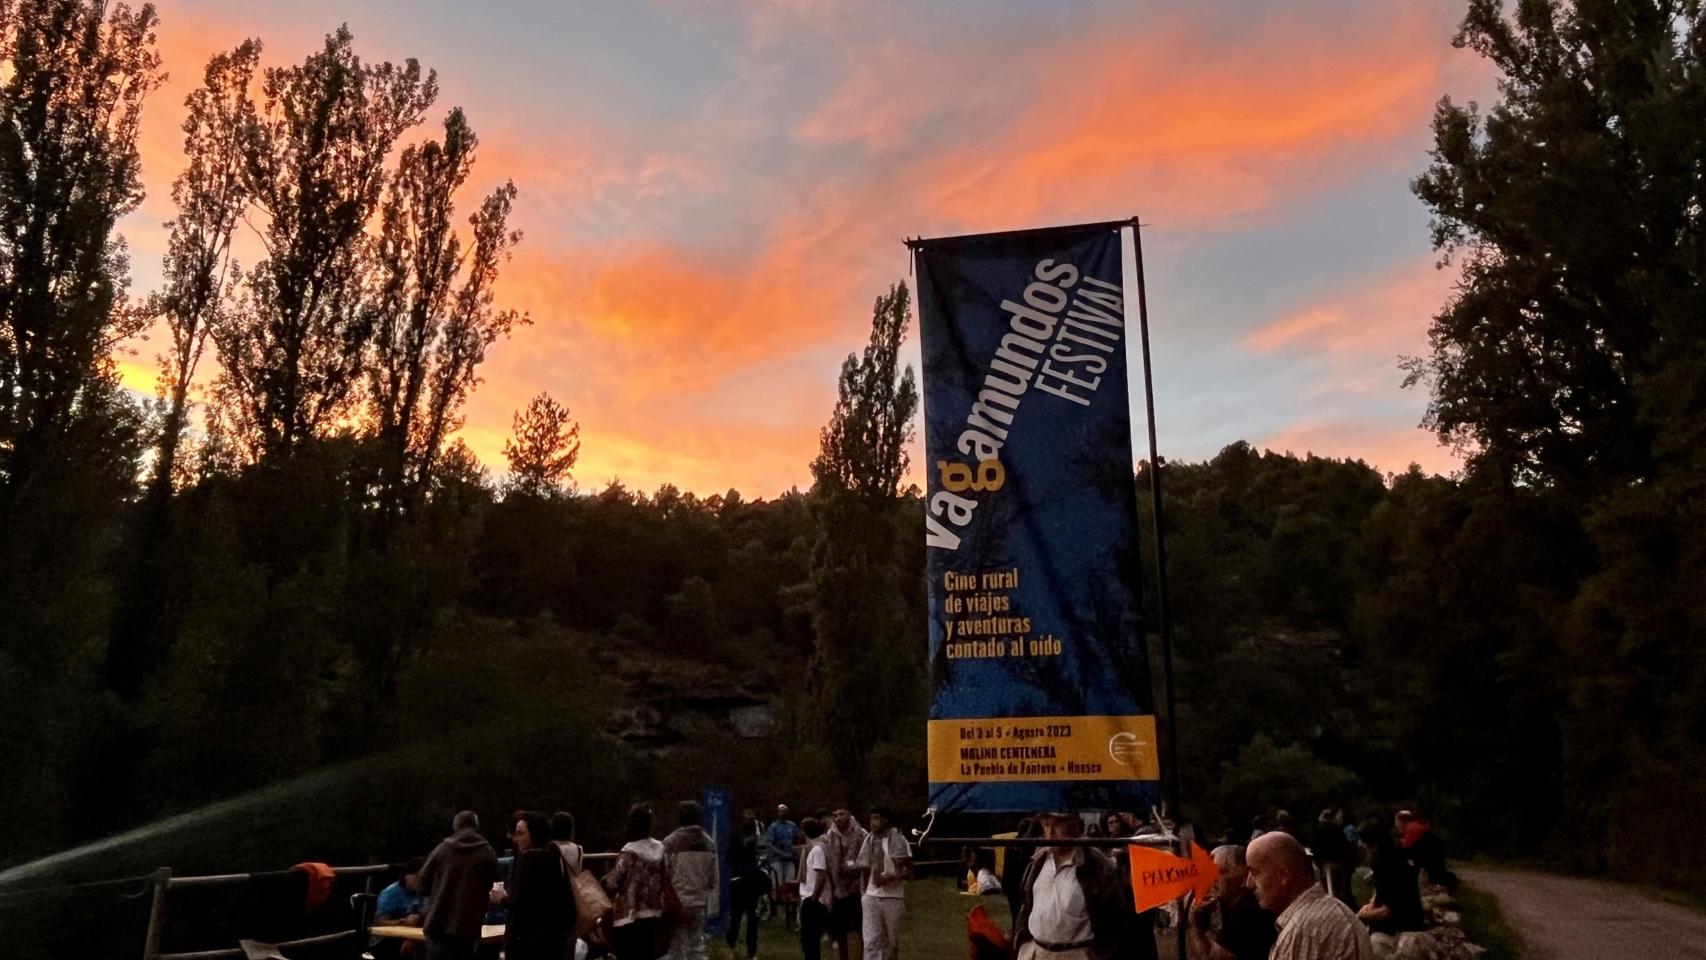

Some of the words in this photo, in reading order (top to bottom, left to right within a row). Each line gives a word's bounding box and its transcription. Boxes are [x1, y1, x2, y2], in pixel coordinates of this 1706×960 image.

[926, 258, 1079, 550] vagamundos
[944, 570, 976, 591] Cine
[982, 568, 1018, 589] rural
[945, 593, 962, 614] de
[966, 592, 1010, 616] viajes
[945, 620, 953, 641] y
[957, 616, 1032, 636] aventuras
[946, 636, 1005, 659] contado
[1010, 636, 1024, 657] al
[960, 728, 974, 739] Del
[985, 727, 993, 738] al
[997, 727, 1002, 738] 5
[1012, 727, 1044, 740] Agosto
[1047, 725, 1071, 737] 2023
[960, 747, 997, 760] MOLINO
[1000, 746, 1056, 759] CENTENERA
[961, 764, 971, 775] La
[974, 763, 1004, 775] Puebla
[1008, 763, 1017, 774] de
[1068, 761, 1101, 774] Huesca
